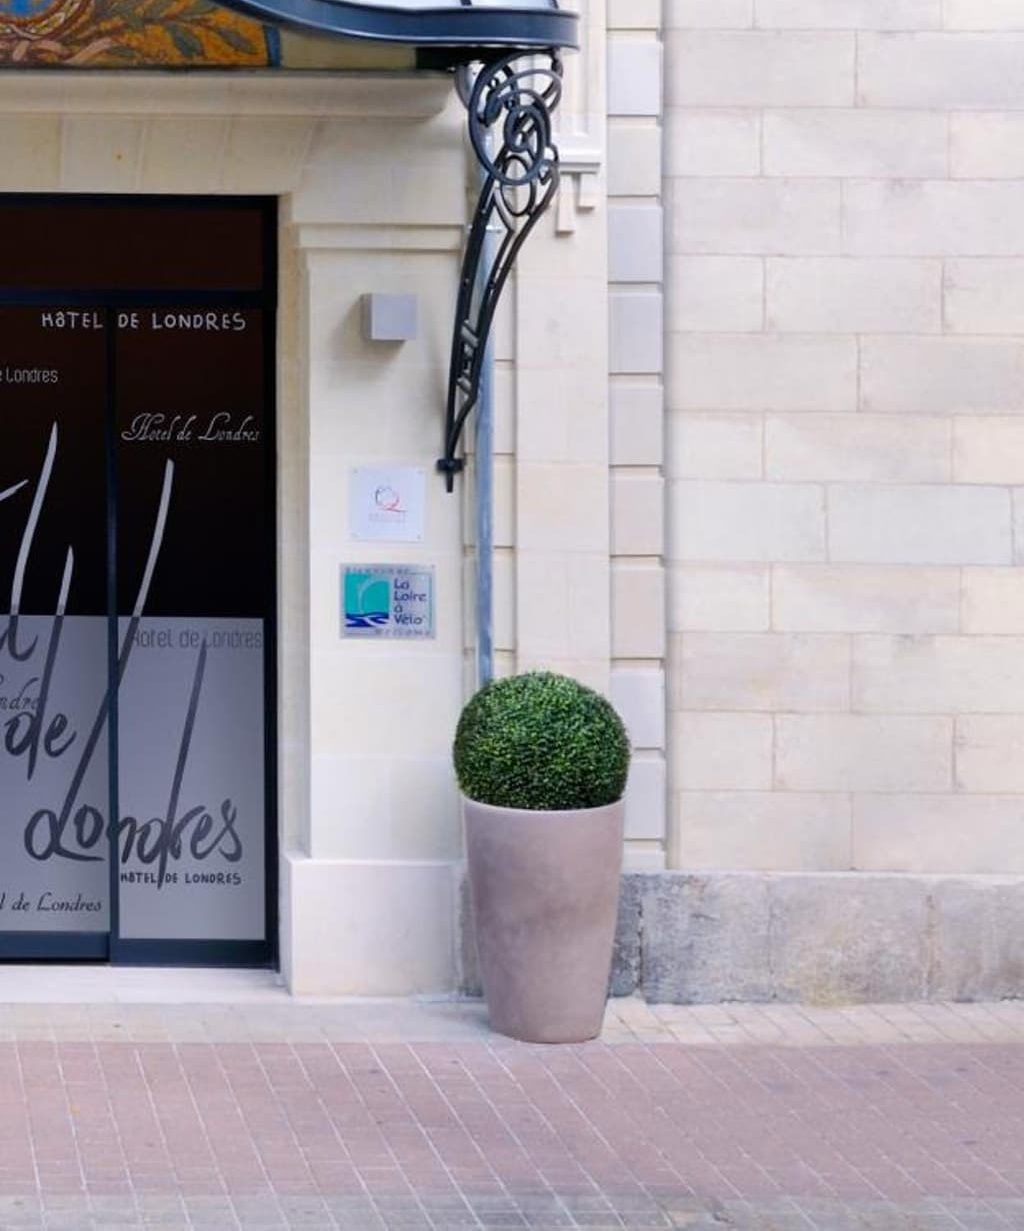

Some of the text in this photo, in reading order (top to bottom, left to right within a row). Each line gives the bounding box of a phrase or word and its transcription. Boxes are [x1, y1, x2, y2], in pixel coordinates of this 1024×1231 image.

[118, 312, 139, 329] DE
[152, 312, 246, 331] LONDRES
[6, 366, 58, 383] Londres
[121, 412, 261, 441] Hotel de Londres
[394, 590, 426, 602] Loire
[179, 628, 200, 649] de
[4, 545, 76, 781] de
[24, 458, 242, 889] Londres
[165, 872, 178, 884] DE
[185, 872, 241, 885] LONDRES
[11, 891, 30, 912] de
[36, 891, 102, 912] Londres
